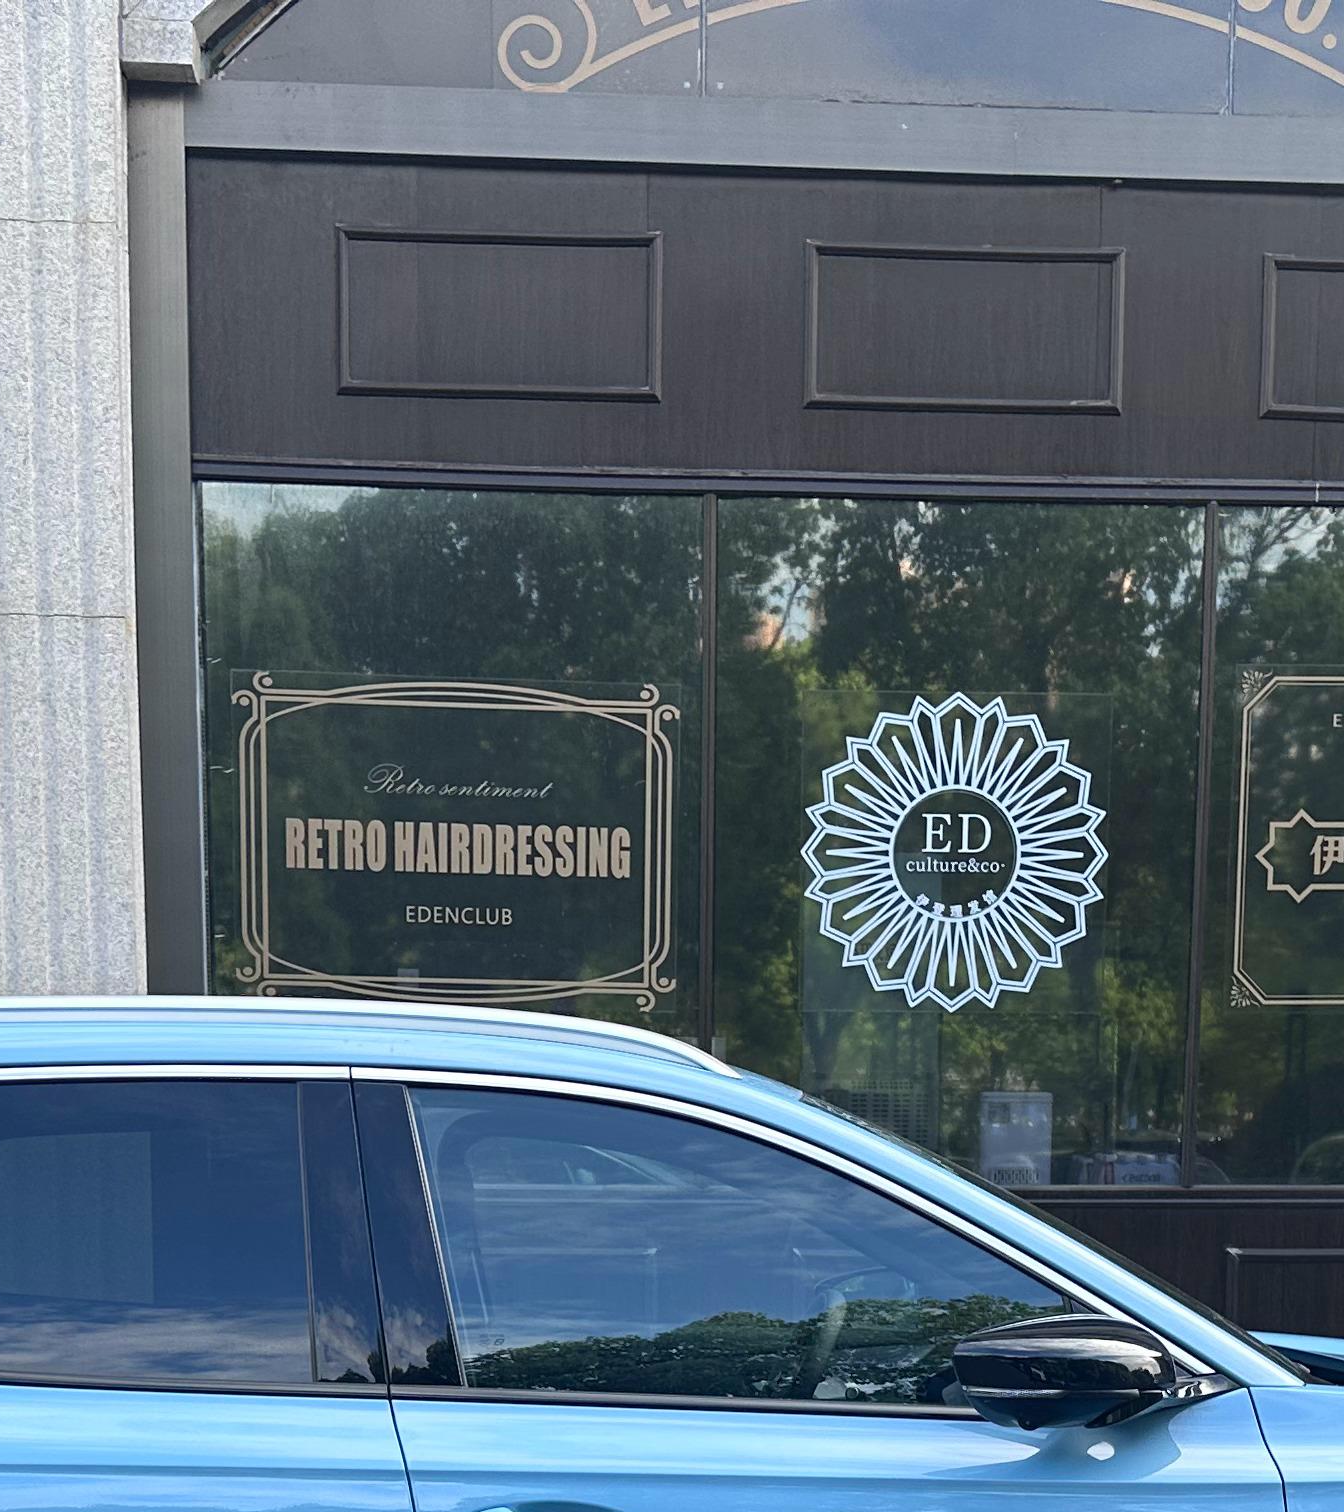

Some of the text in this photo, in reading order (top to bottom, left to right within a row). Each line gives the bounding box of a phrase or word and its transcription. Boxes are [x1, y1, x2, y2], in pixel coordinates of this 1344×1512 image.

[285, 817, 631, 880] RETRO HAIRDRESSING
[921, 813, 992, 853] ED
[406, 905, 513, 926] EDENCLUB
